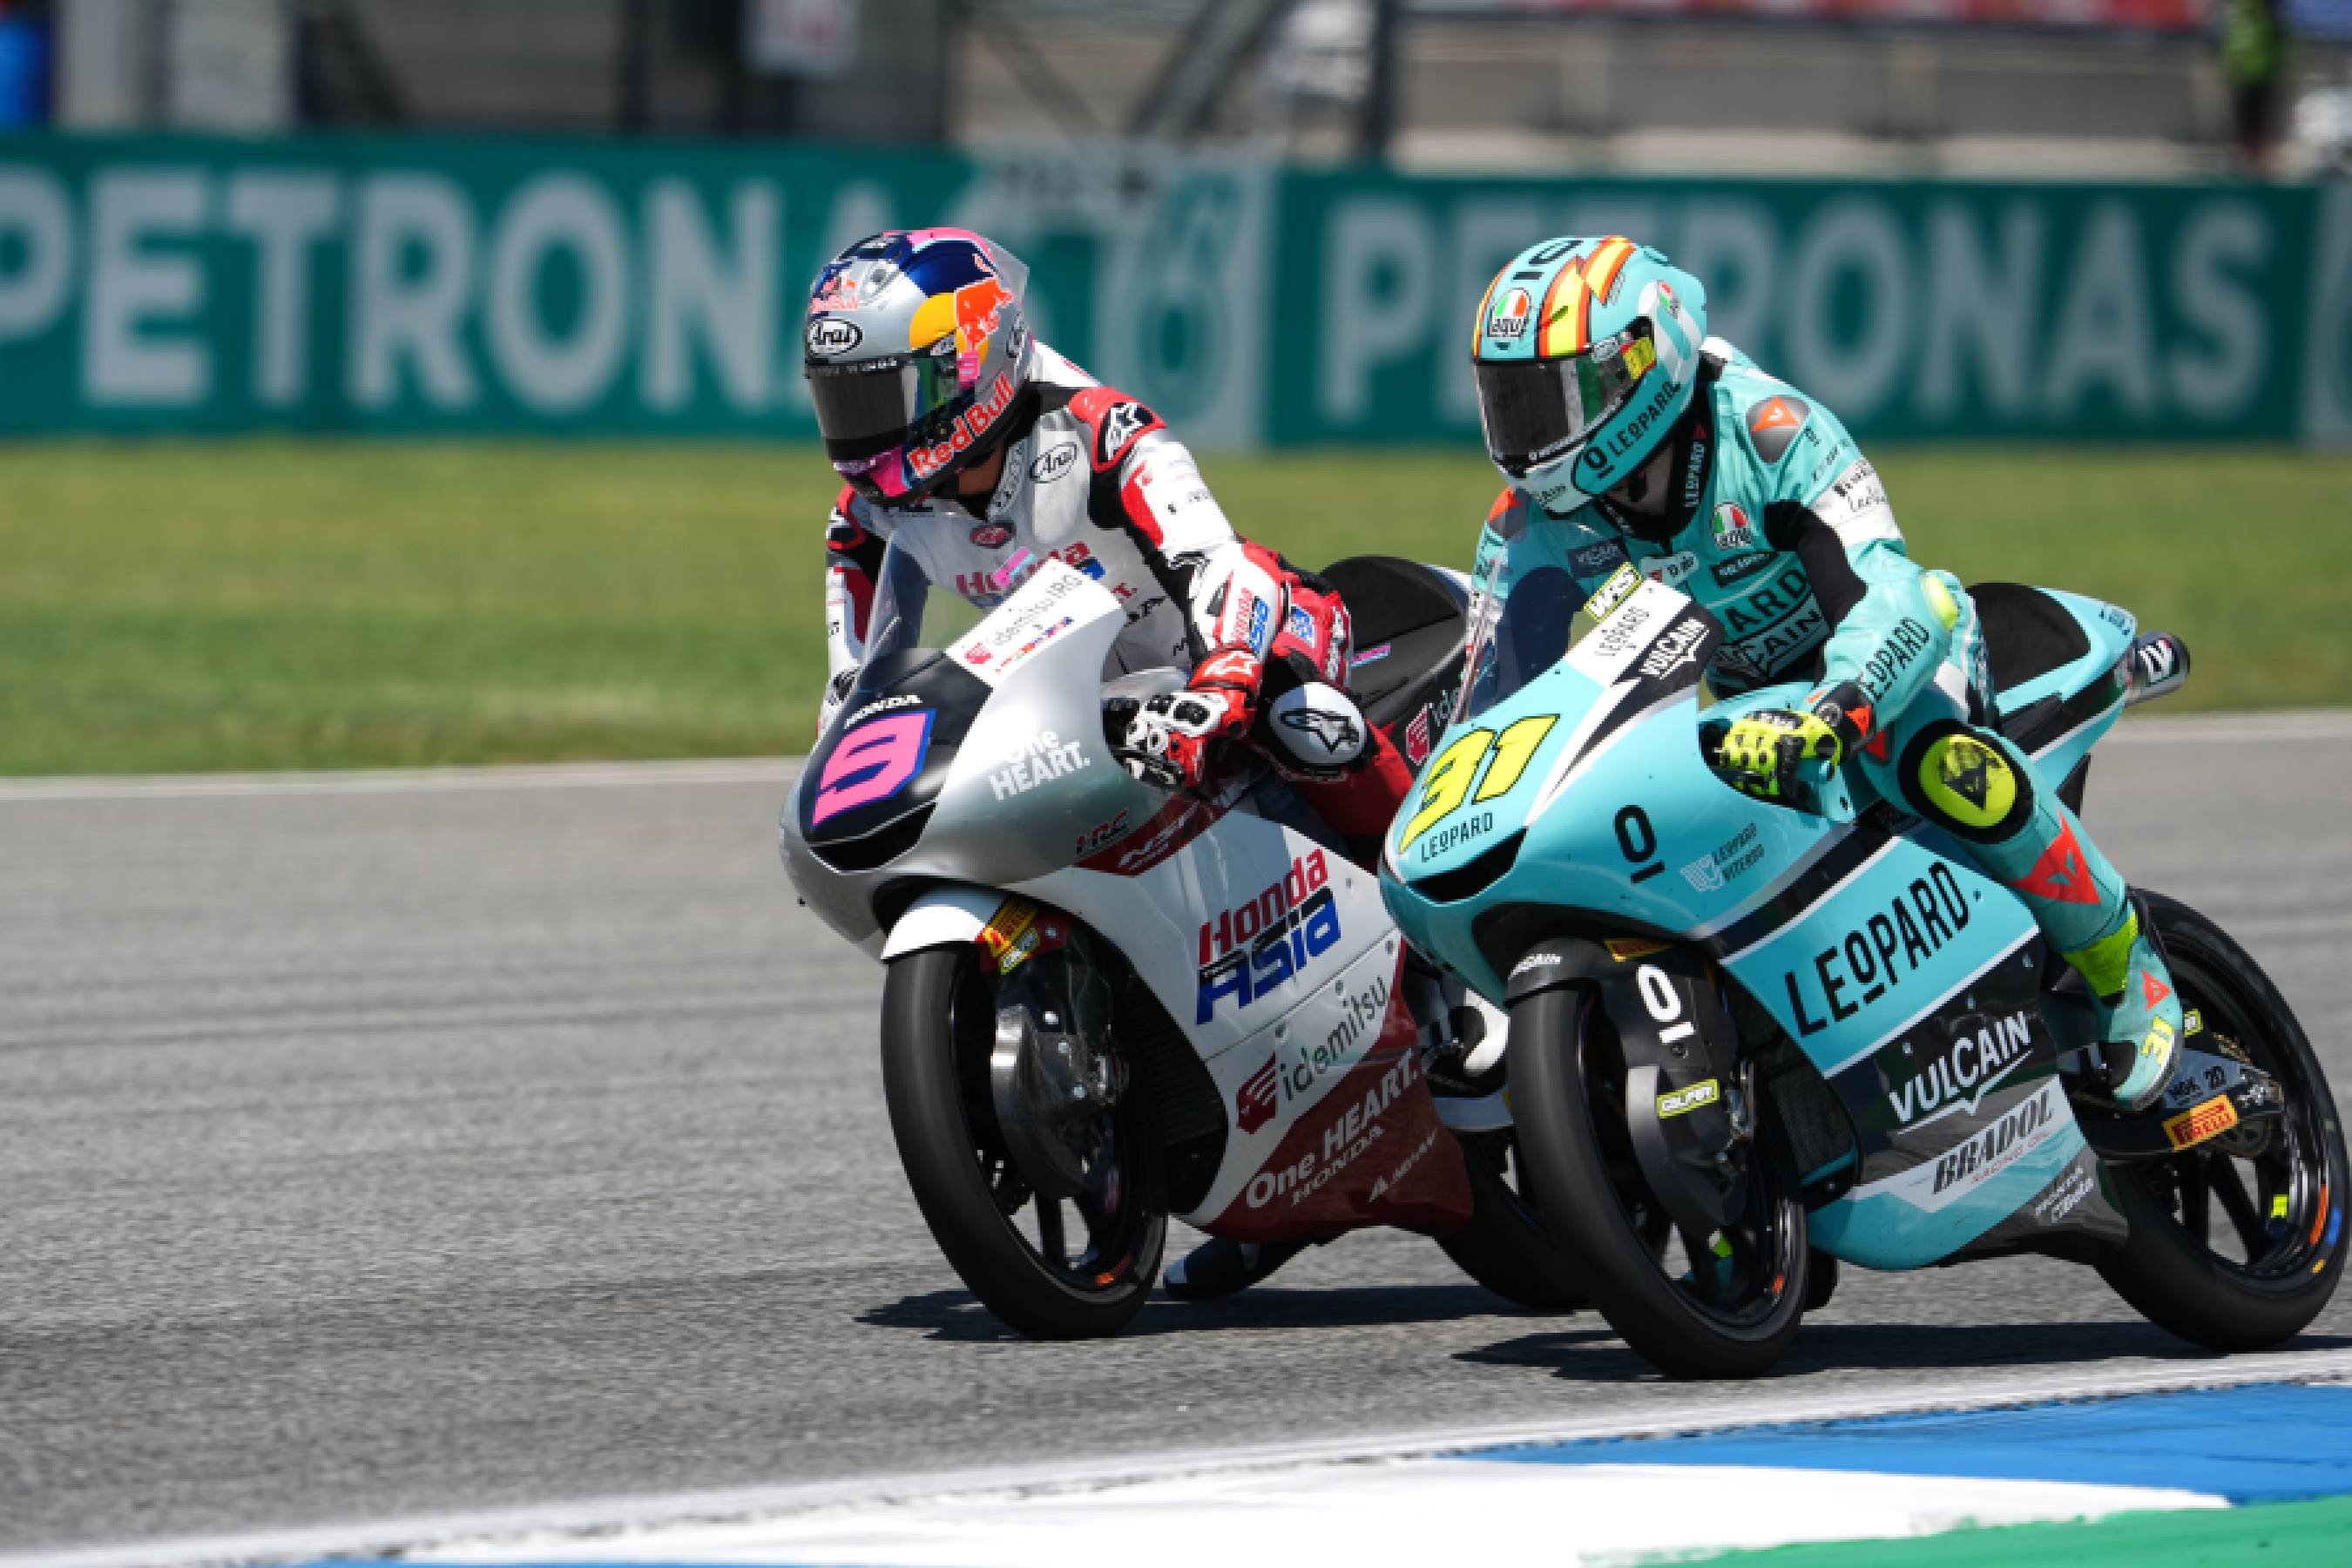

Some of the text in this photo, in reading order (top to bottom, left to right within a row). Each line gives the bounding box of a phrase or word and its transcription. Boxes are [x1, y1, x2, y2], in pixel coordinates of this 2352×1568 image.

[0, 166, 1045, 413] PETRON
[811, 322, 851, 346] Arai
[908, 416, 974, 478] Red
[964, 375, 1016, 436] Bull
[1605, 379, 1681, 459] LEOPARD
[1639, 617, 1707, 676] VULCAIN
[1856, 616, 1930, 703] EOPARD
[843, 693, 923, 730] HONDA
[812, 712, 936, 830] 9
[988, 740, 1092, 802] HEART.
[1397, 713, 1561, 855] 31
[1420, 811, 1494, 863] LEOPARD
[1199, 847, 1329, 967] Honda
[1784, 860, 1970, 1038] LEOPARD
[1279, 975, 1390, 1101] idemitsu
[1889, 1010, 2032, 1124] VULCAIN
[1291, 1125, 1385, 1206] HONDA
[1932, 1088, 2055, 1195] BRADOL
[2170, 1103, 2235, 1146] PIRELLI
[1246, 1151, 1315, 1209] One
